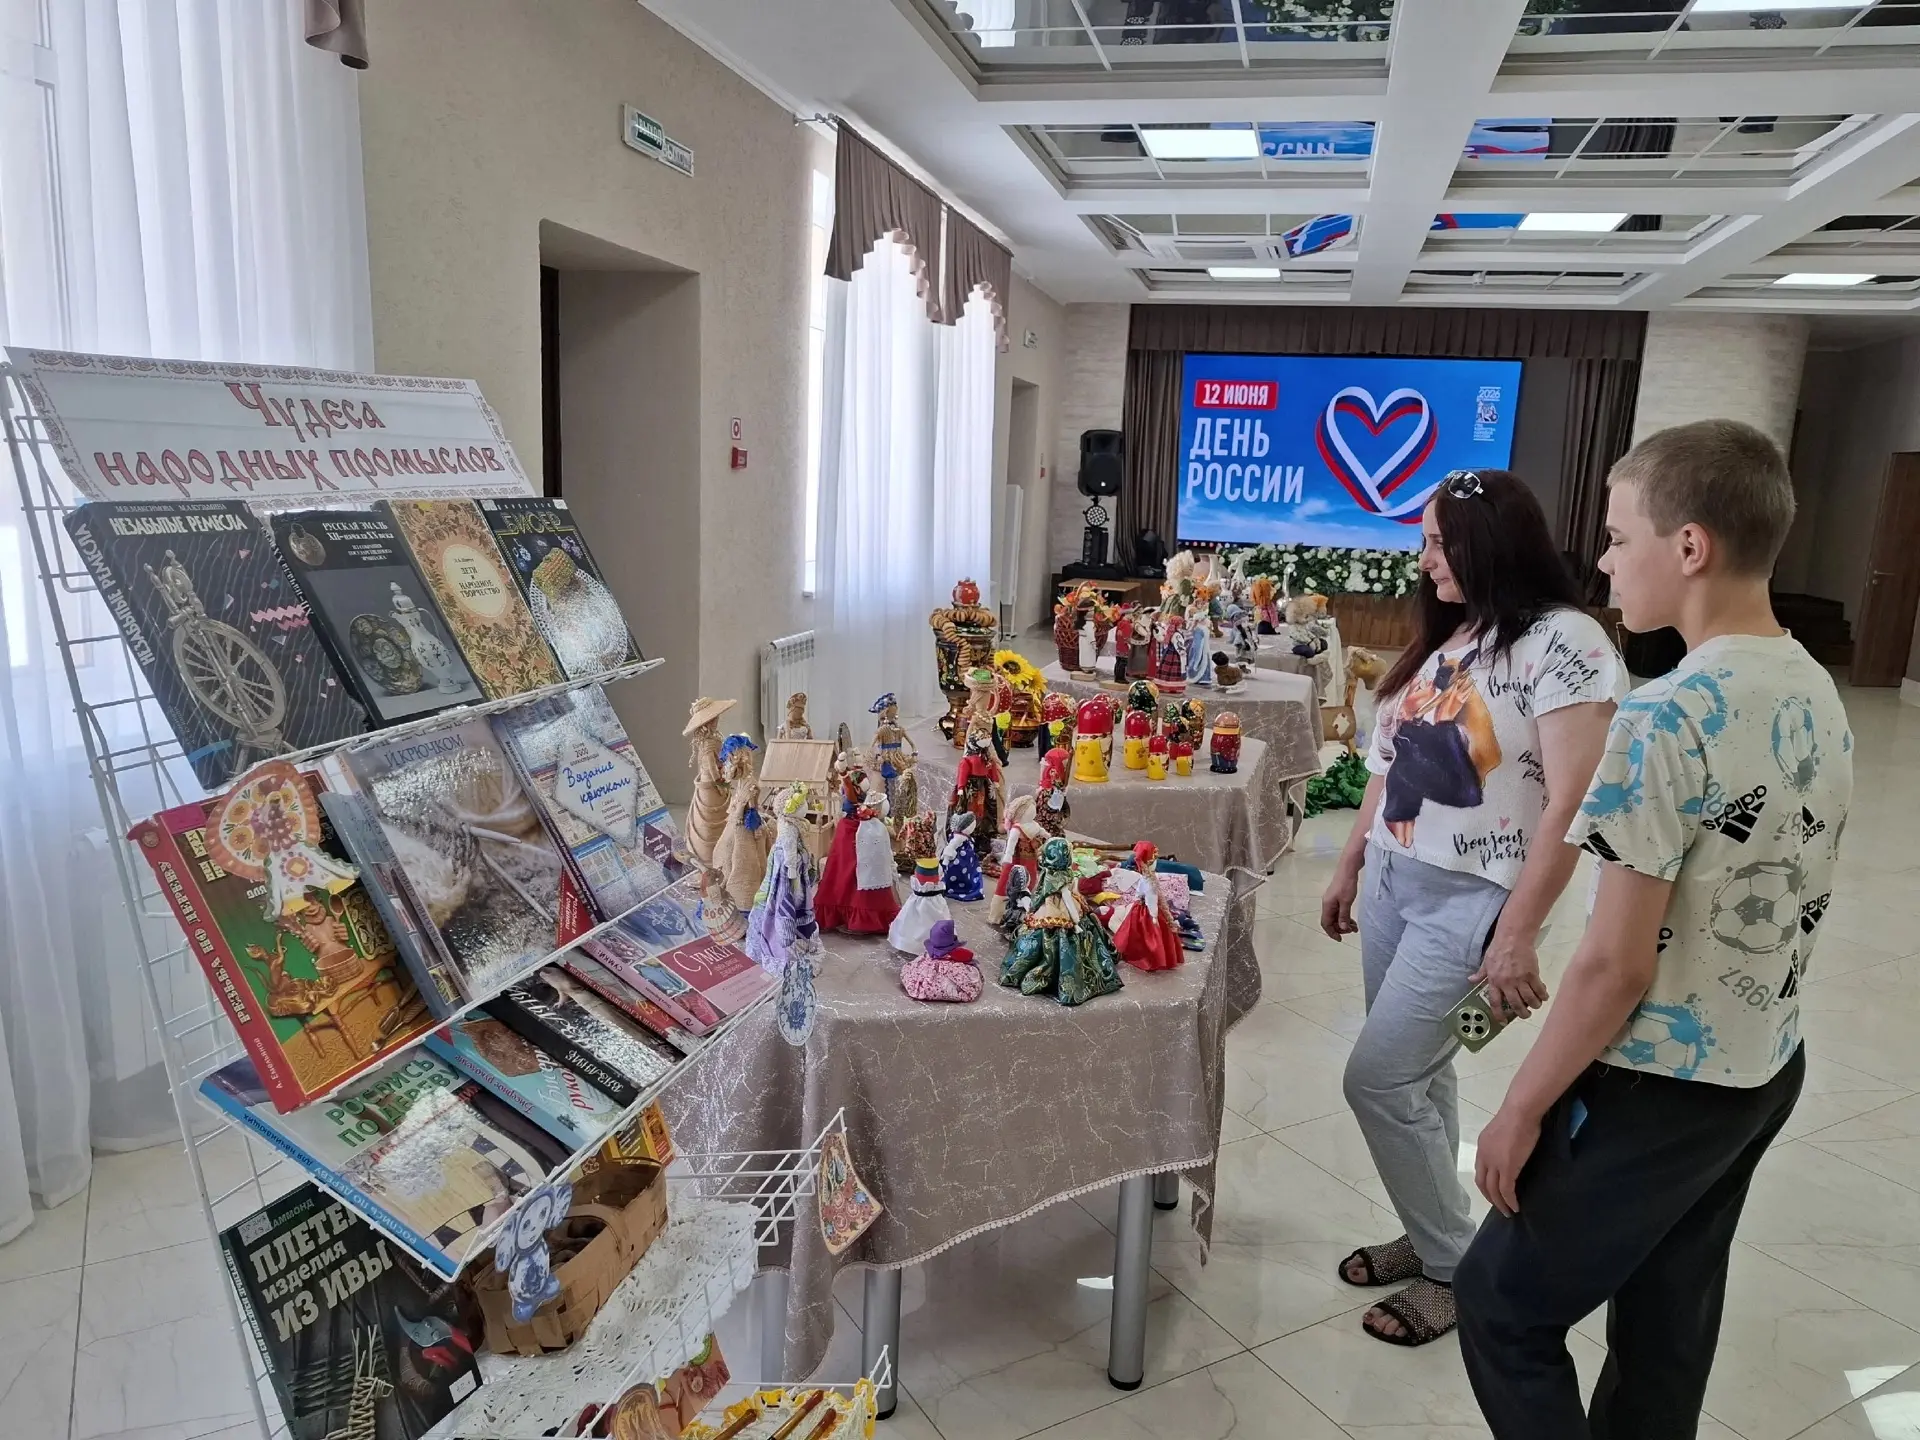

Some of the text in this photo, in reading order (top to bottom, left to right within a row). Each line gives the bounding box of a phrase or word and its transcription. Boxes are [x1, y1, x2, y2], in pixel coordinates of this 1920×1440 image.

[1203, 384, 1269, 406] 12 ИЮНЯ
[1479, 389, 1501, 400] 2026
[224, 382, 386, 443] Чудеса
[1189, 417, 1270, 460] ДЕНЬ
[94, 446, 505, 498] народных промыслов
[1185, 462, 1304, 504] РОССИИ
[109, 514, 248, 536] НЕЗАБЫТЫЕ РЕМЕСЛА
[459, 580, 494, 590] НАРОДНОЕ
[460, 566, 478, 575] ДЕТИ
[74, 523, 155, 667] НЕЗАБЫТЫЕ РЕМЕСЛА
[460, 587, 500, 599] ТВОРЧЕСТВО
[397, 734, 466, 767] КРЮЧКОМ
[562, 760, 615, 788] Вязание
[580, 777, 631, 811] крючком
[1453, 828, 1529, 857] Bonjour
[158, 861, 201, 925] ДЕРЕВУ
[195, 928, 214, 955] ПО
[211, 957, 251, 1025] РЕЗЬБА
[1717, 968, 1775, 1012] 1987
[338, 1118, 379, 1148] ПО
[314, 1166, 354, 1199] ДЕРЕВУ
[272, 1198, 315, 1229] АММОНД
[352, 1193, 370, 1209] ПО
[370, 1205, 418, 1245] РОСПИСЬ
[261, 1240, 347, 1304] изделия
[271, 1239, 393, 1343] ИЗ ИВЫ
